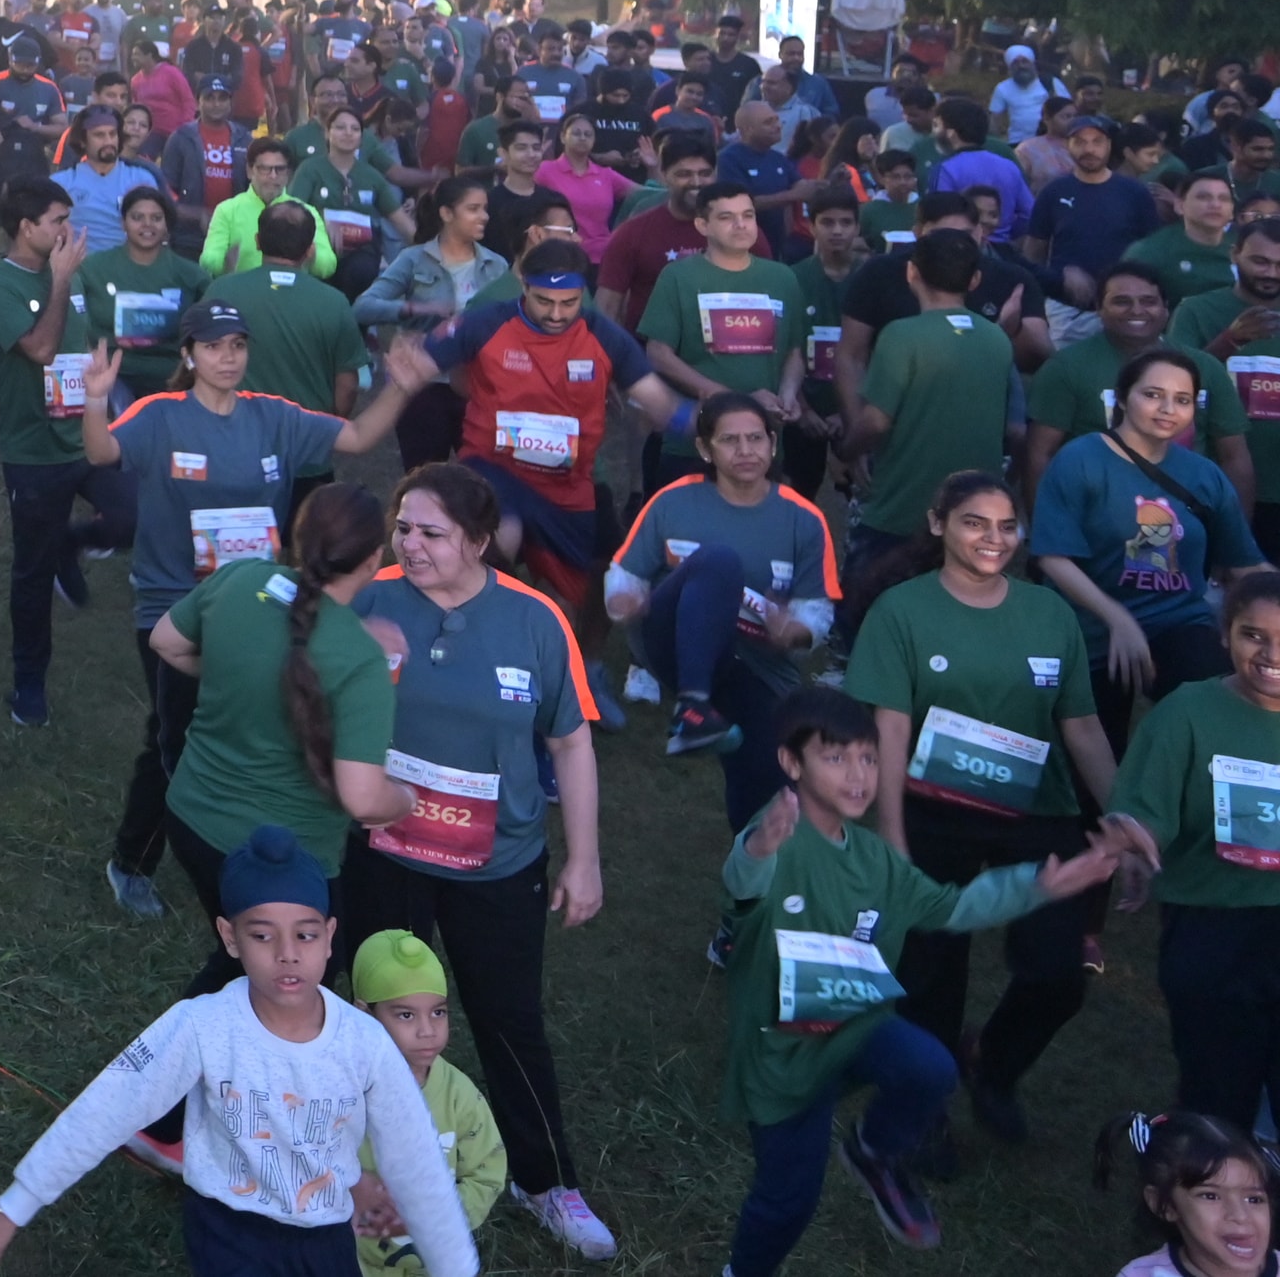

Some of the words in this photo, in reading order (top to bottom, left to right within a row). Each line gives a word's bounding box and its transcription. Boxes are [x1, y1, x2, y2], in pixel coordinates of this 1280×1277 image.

[724, 315, 762, 328] 5414
[517, 435, 567, 454] 10244
[1117, 569, 1193, 592] FENDI
[951, 749, 1013, 784] 3019
[411, 798, 472, 828] 5362
[405, 844, 421, 855] SUN
[423, 848, 444, 860] VIEW
[445, 854, 484, 868] ENCLAVE
[220, 1081, 271, 1139] BE
